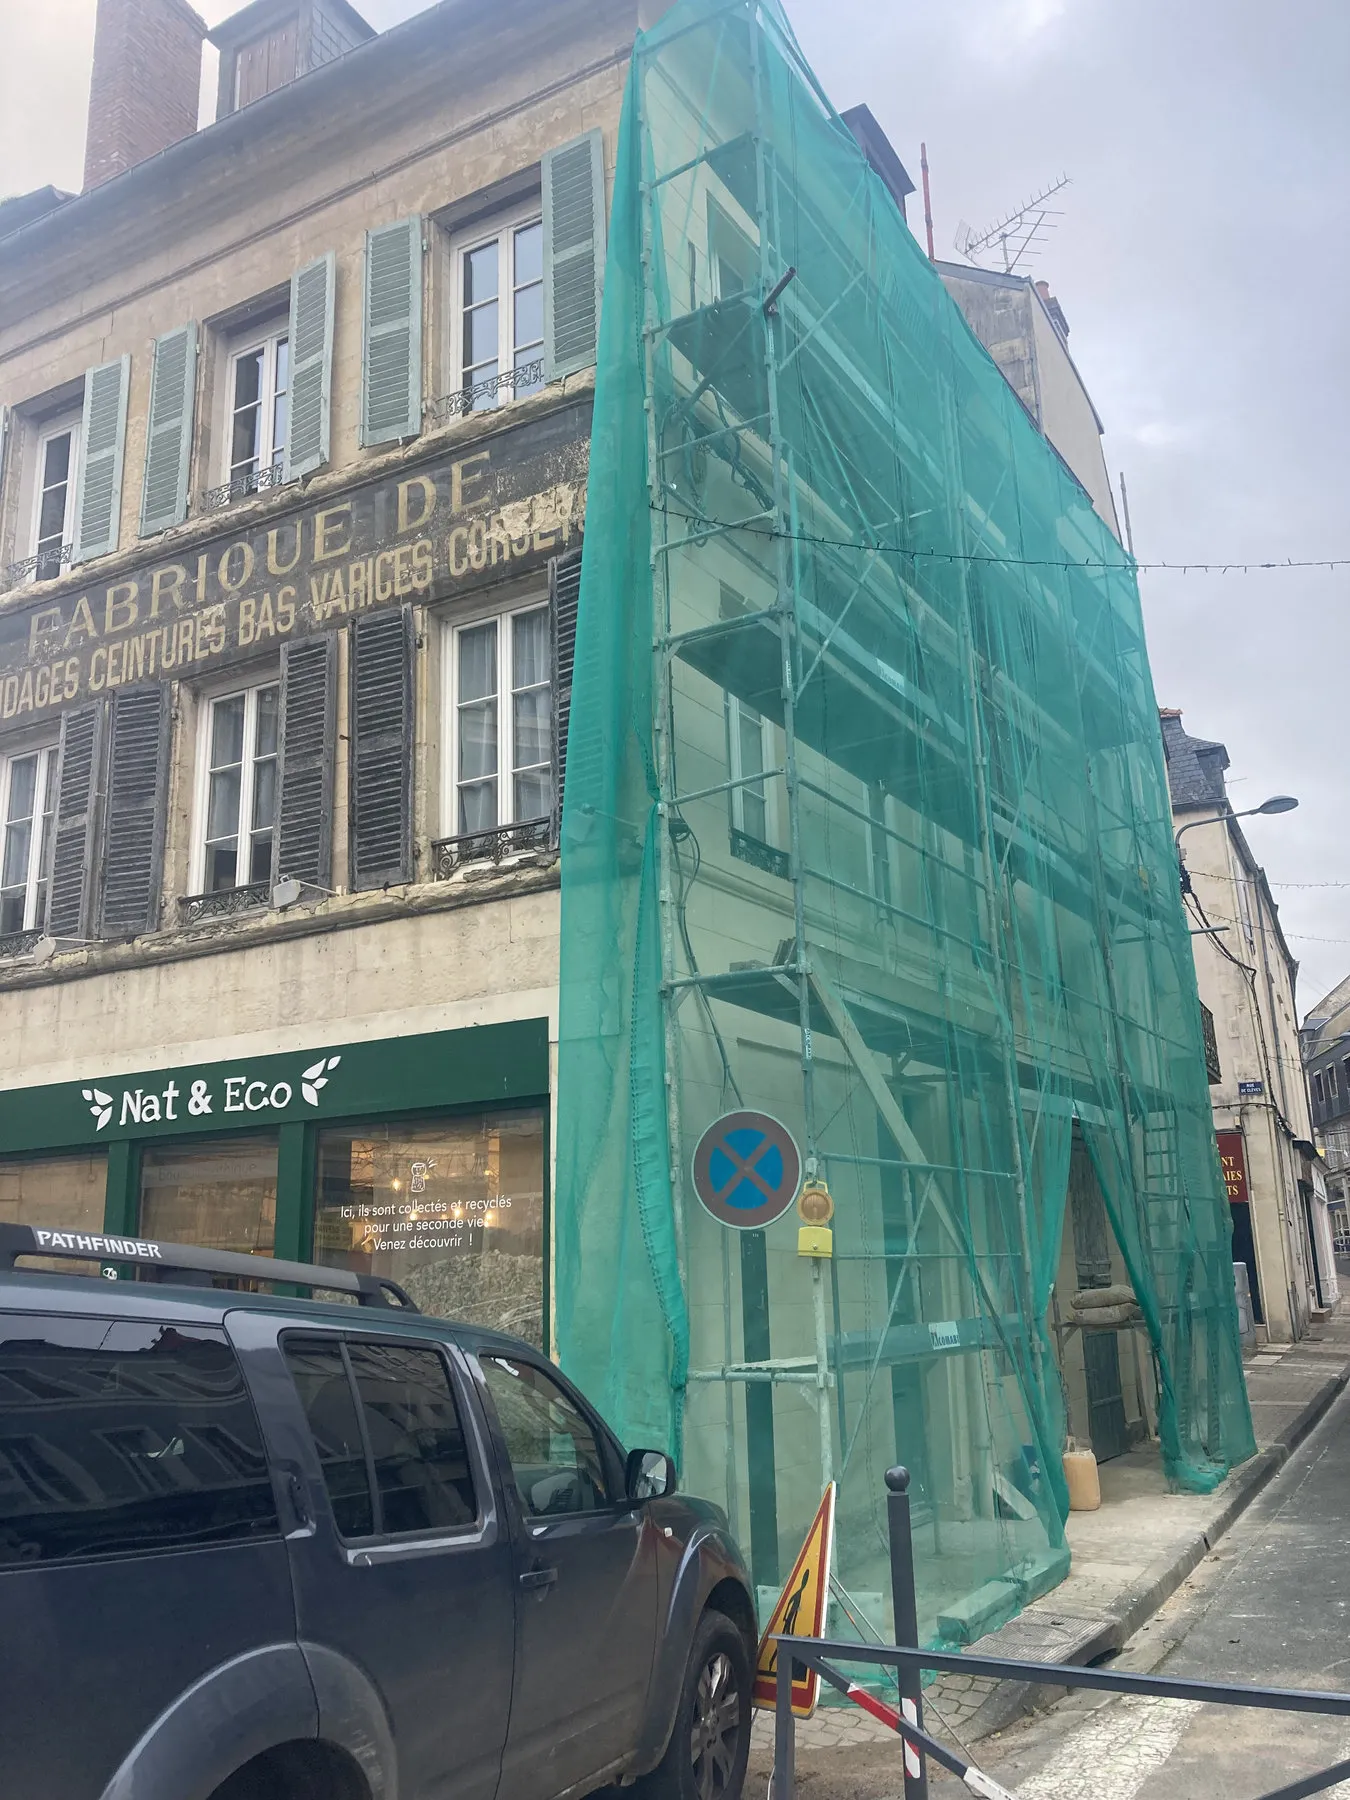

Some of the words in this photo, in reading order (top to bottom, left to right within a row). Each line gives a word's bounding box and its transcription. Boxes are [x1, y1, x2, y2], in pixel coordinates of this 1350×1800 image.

[28, 502, 352, 658] FABRIQUE
[397, 449, 490, 535] DE
[88, 608, 226, 692] CEINTURES
[238, 586, 296, 646] BAS
[310, 539, 433, 621] VARICES
[119, 1081, 180, 1126] Nat
[188, 1079, 213, 1116] &
[224, 1076, 292, 1112] Eco
[341, 1205, 355, 1219] Ici,
[359, 1203, 370, 1217] ils
[372, 1205, 396, 1216] sont
[399, 1199, 447, 1215] collectés
[450, 1199, 462, 1210] et
[465, 1195, 512, 1212] recyclés
[364, 1222, 390, 1236] pour
[393, 1221, 413, 1232] une
[416, 1217, 464, 1231] seconde
[36, 1230, 162, 1259] PATHFINDER
[374, 1237, 406, 1251] Venez
[409, 1234, 463, 1249] découvrir
[468, 1232, 473, 1246] !
